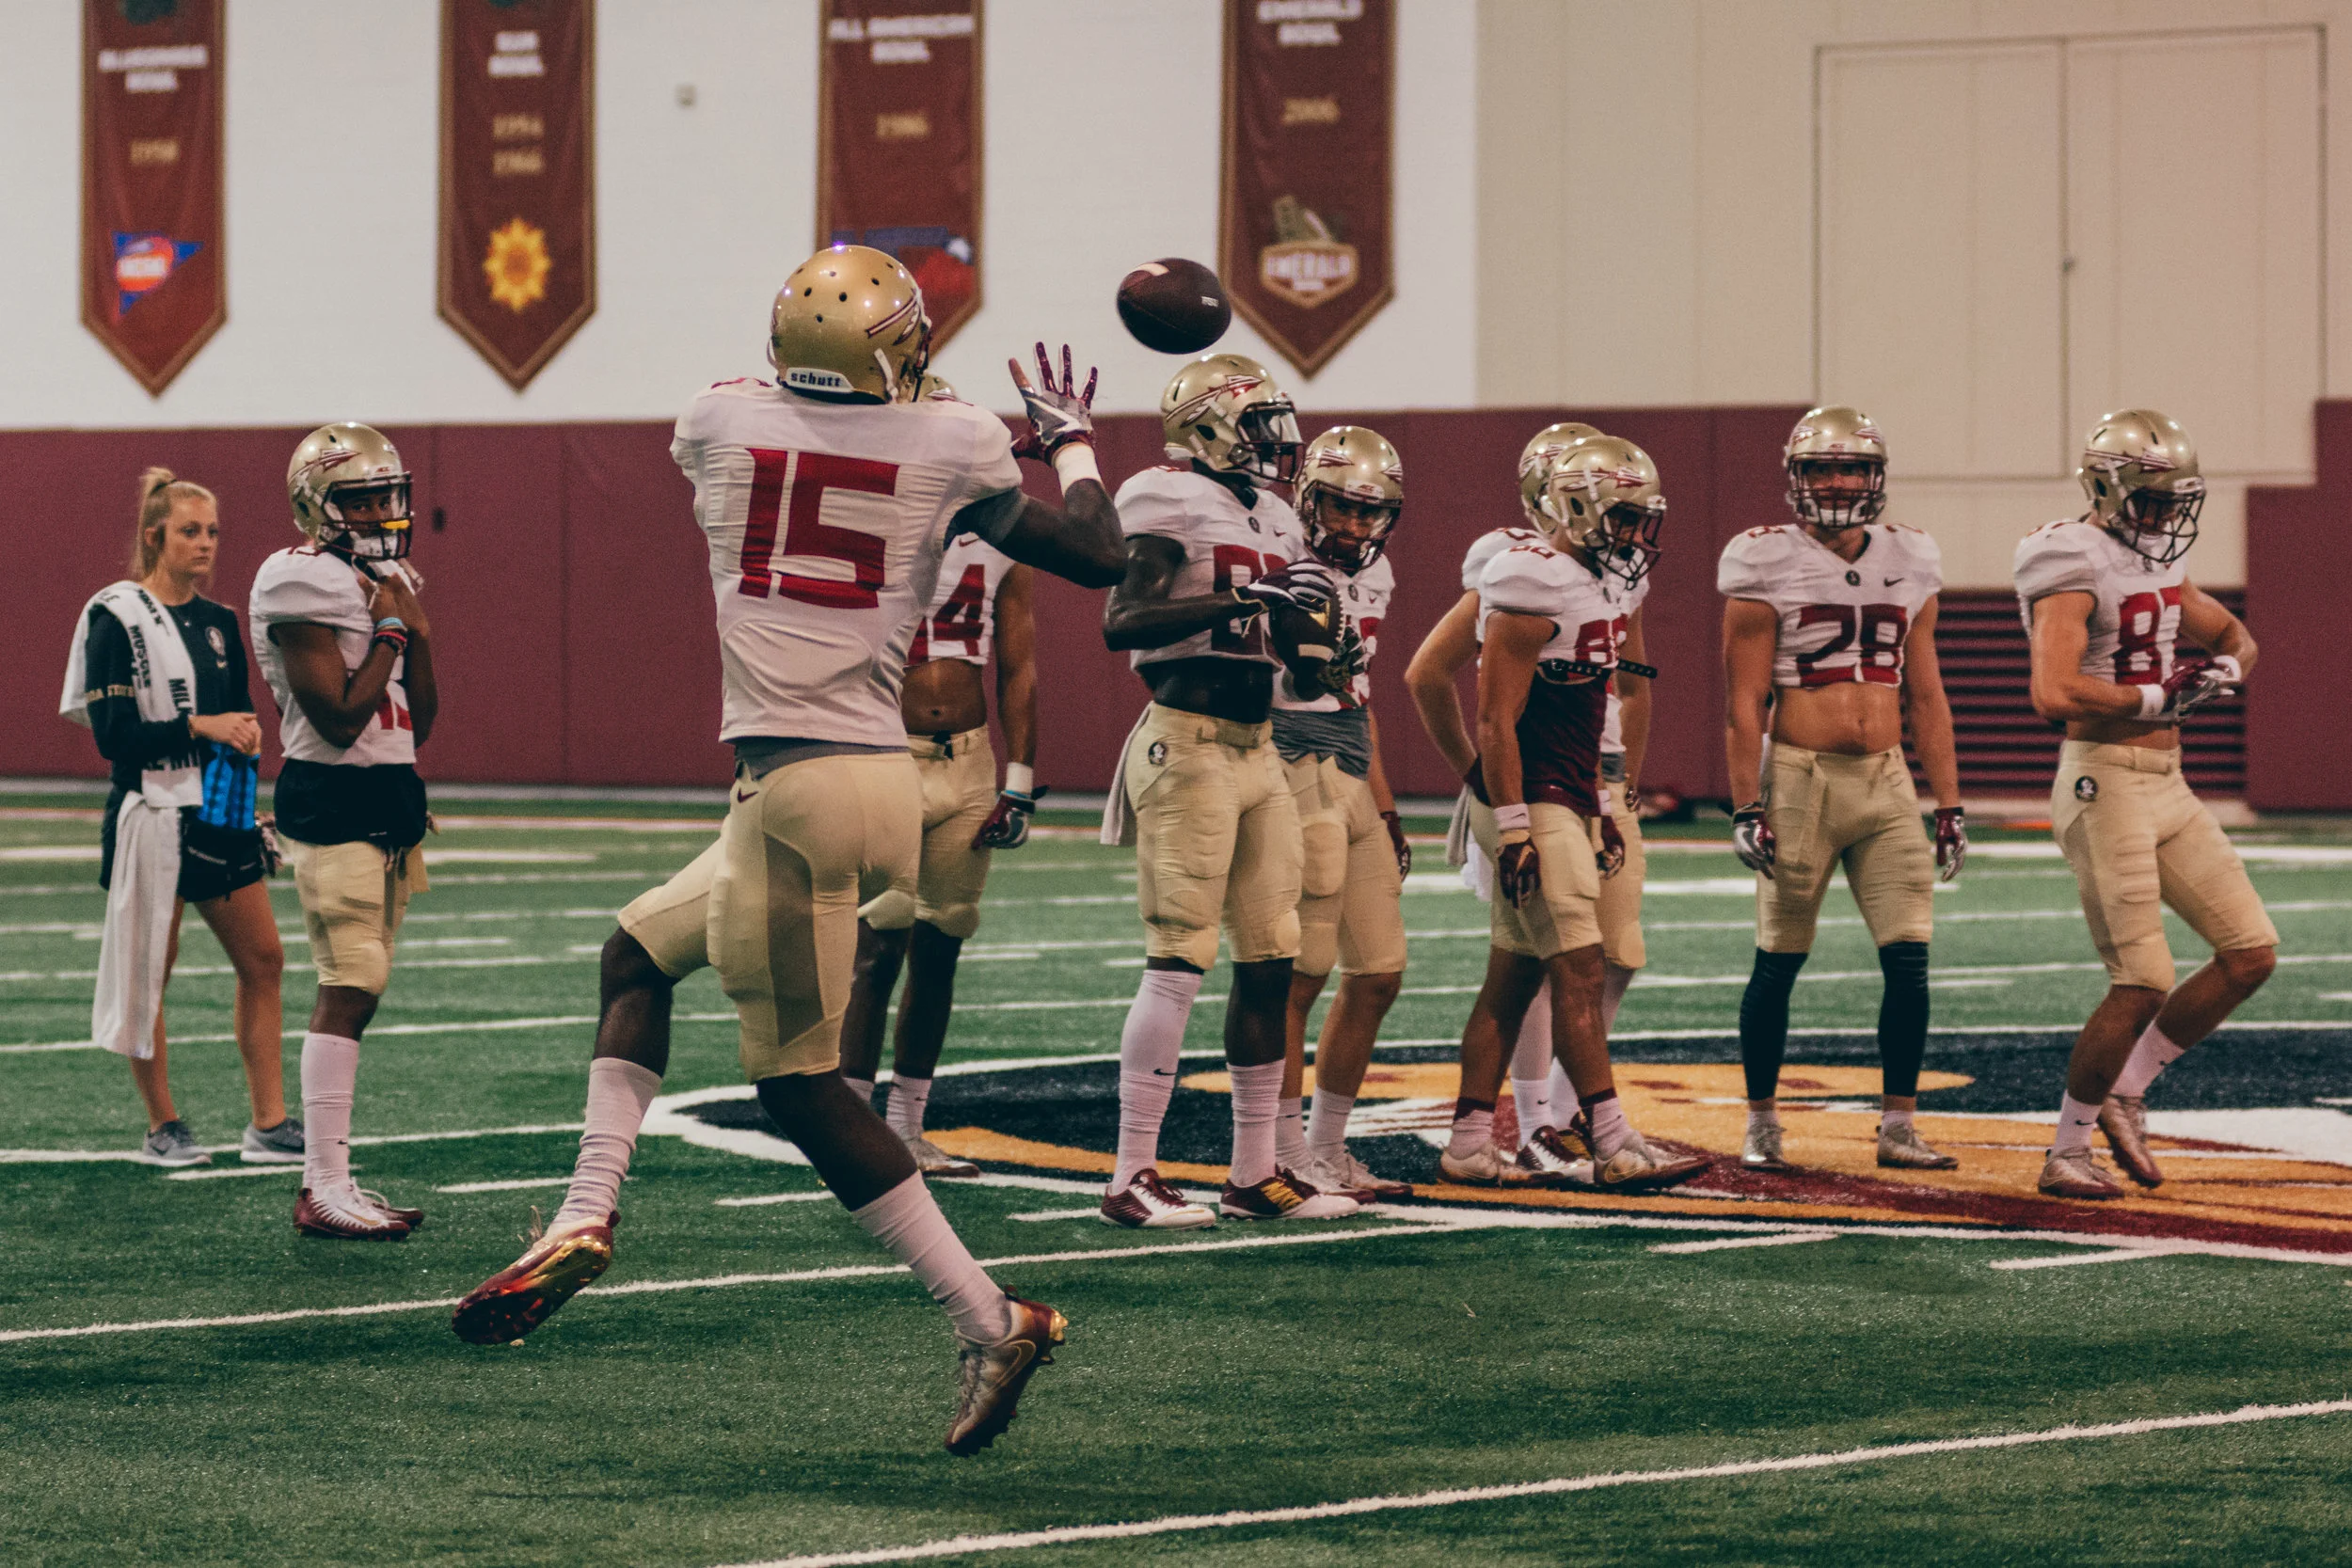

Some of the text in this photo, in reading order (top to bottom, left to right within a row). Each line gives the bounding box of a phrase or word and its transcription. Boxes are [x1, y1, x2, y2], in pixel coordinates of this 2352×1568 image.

[790, 371, 841, 388] schutt
[739, 448, 899, 609] 15
[1796, 603, 1907, 689] 28
